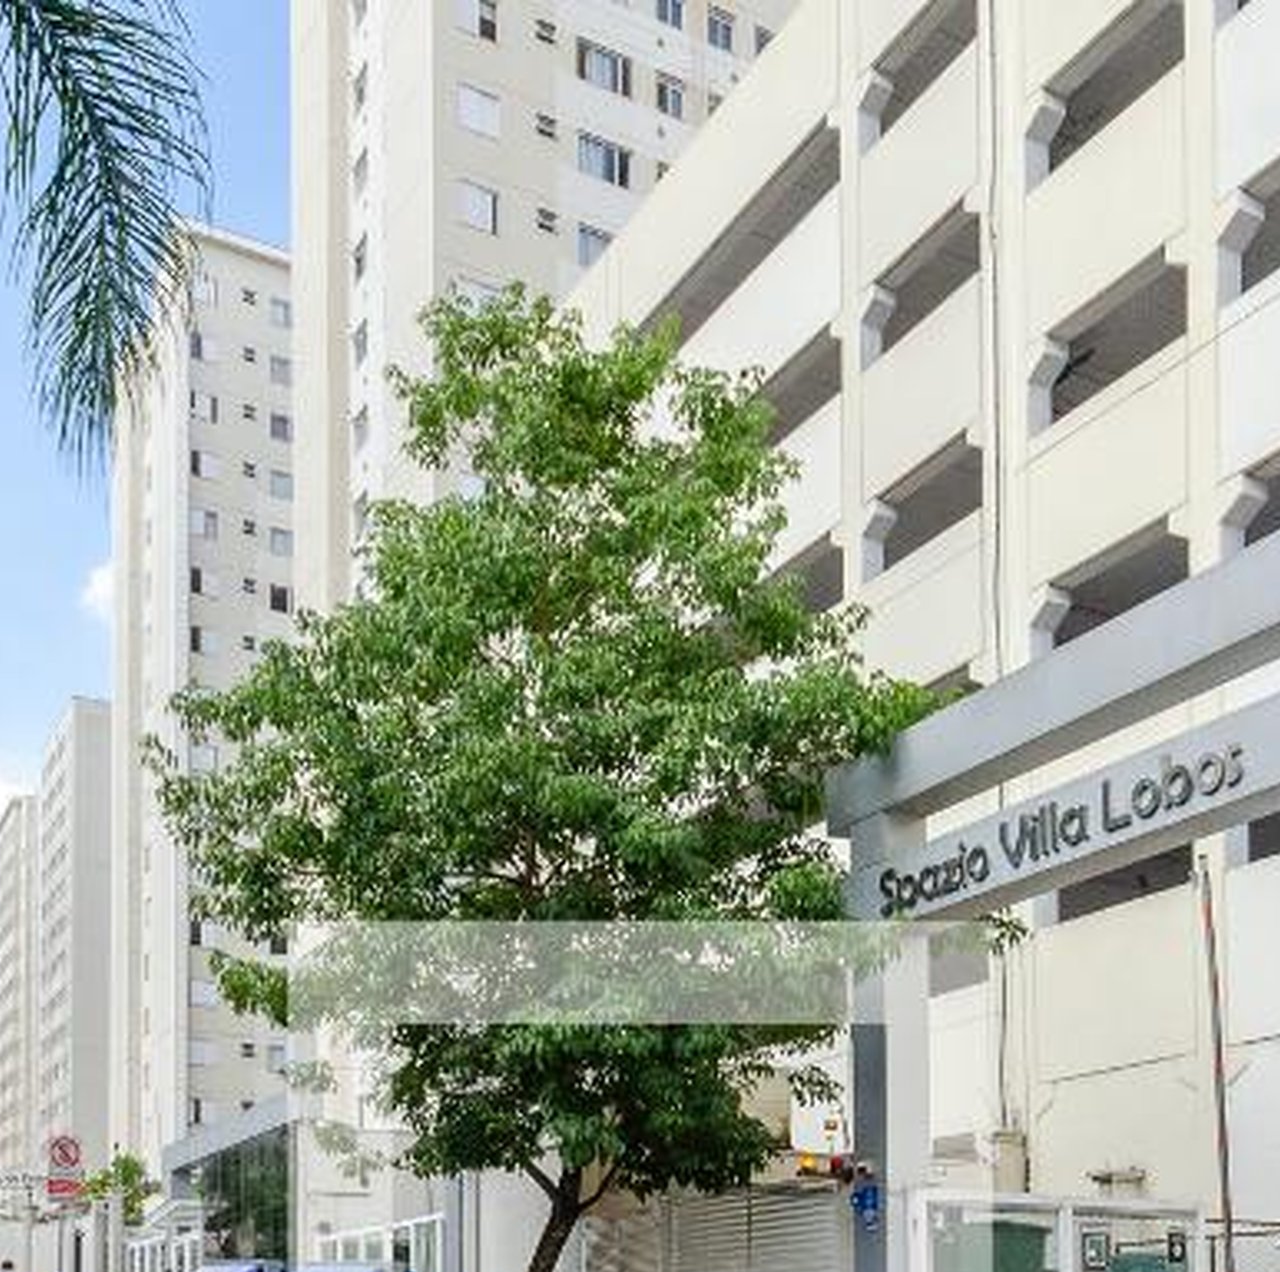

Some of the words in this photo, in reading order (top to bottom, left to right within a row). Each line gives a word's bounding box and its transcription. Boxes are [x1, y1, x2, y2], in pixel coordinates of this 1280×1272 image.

[879, 840, 990, 918] Spazio
[999, 801, 1090, 869] Villa
[1102, 747, 1244, 832] Lobos
